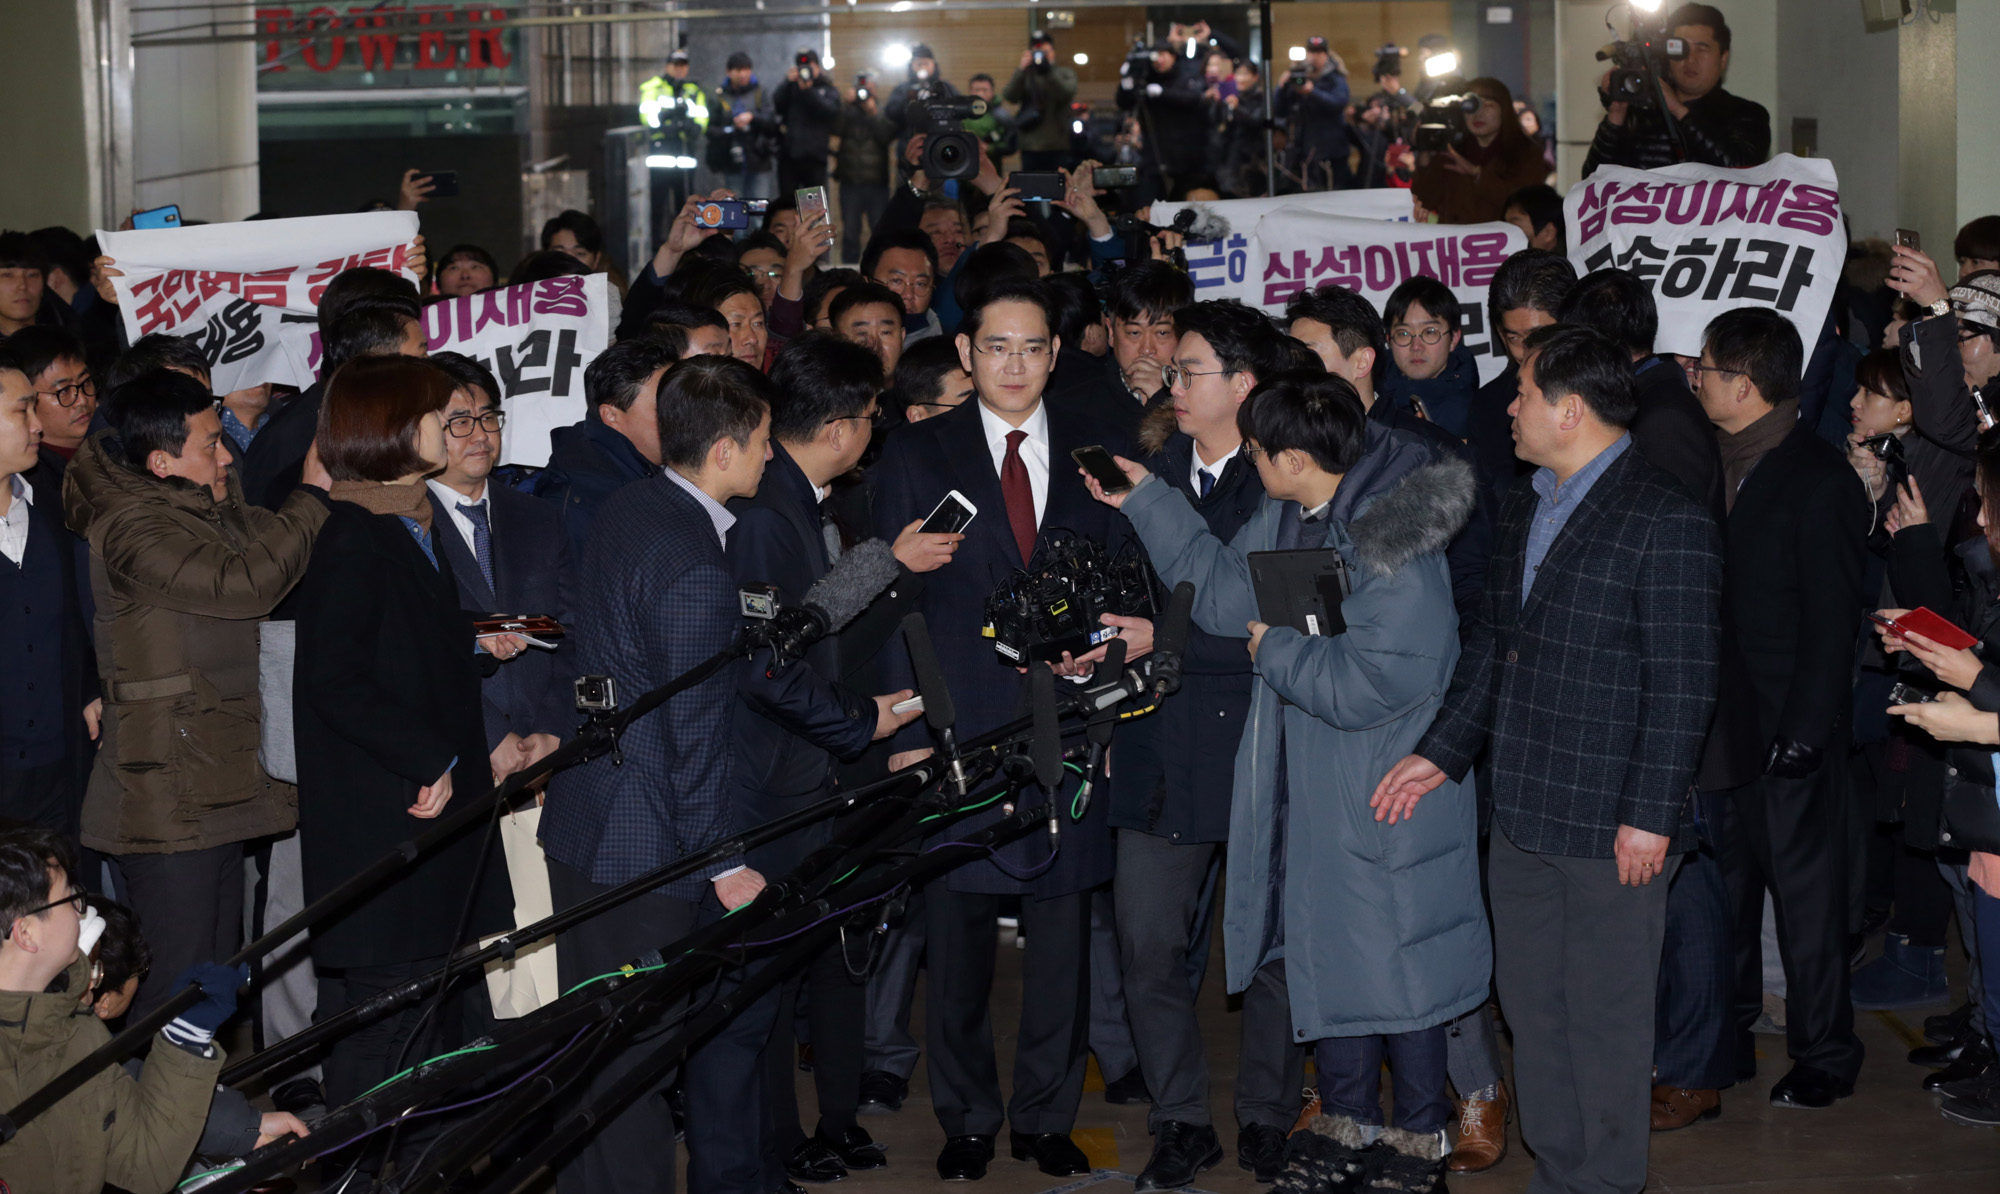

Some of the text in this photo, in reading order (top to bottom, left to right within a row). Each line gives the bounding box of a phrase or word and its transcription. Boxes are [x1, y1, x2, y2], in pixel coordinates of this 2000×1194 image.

[256, 4, 512, 73] TOWER
[1578, 178, 1839, 246] 삼성이재용
[1263, 231, 1508, 306] 삼성이재용
[1949, 286, 2000, 312] INTAGE
